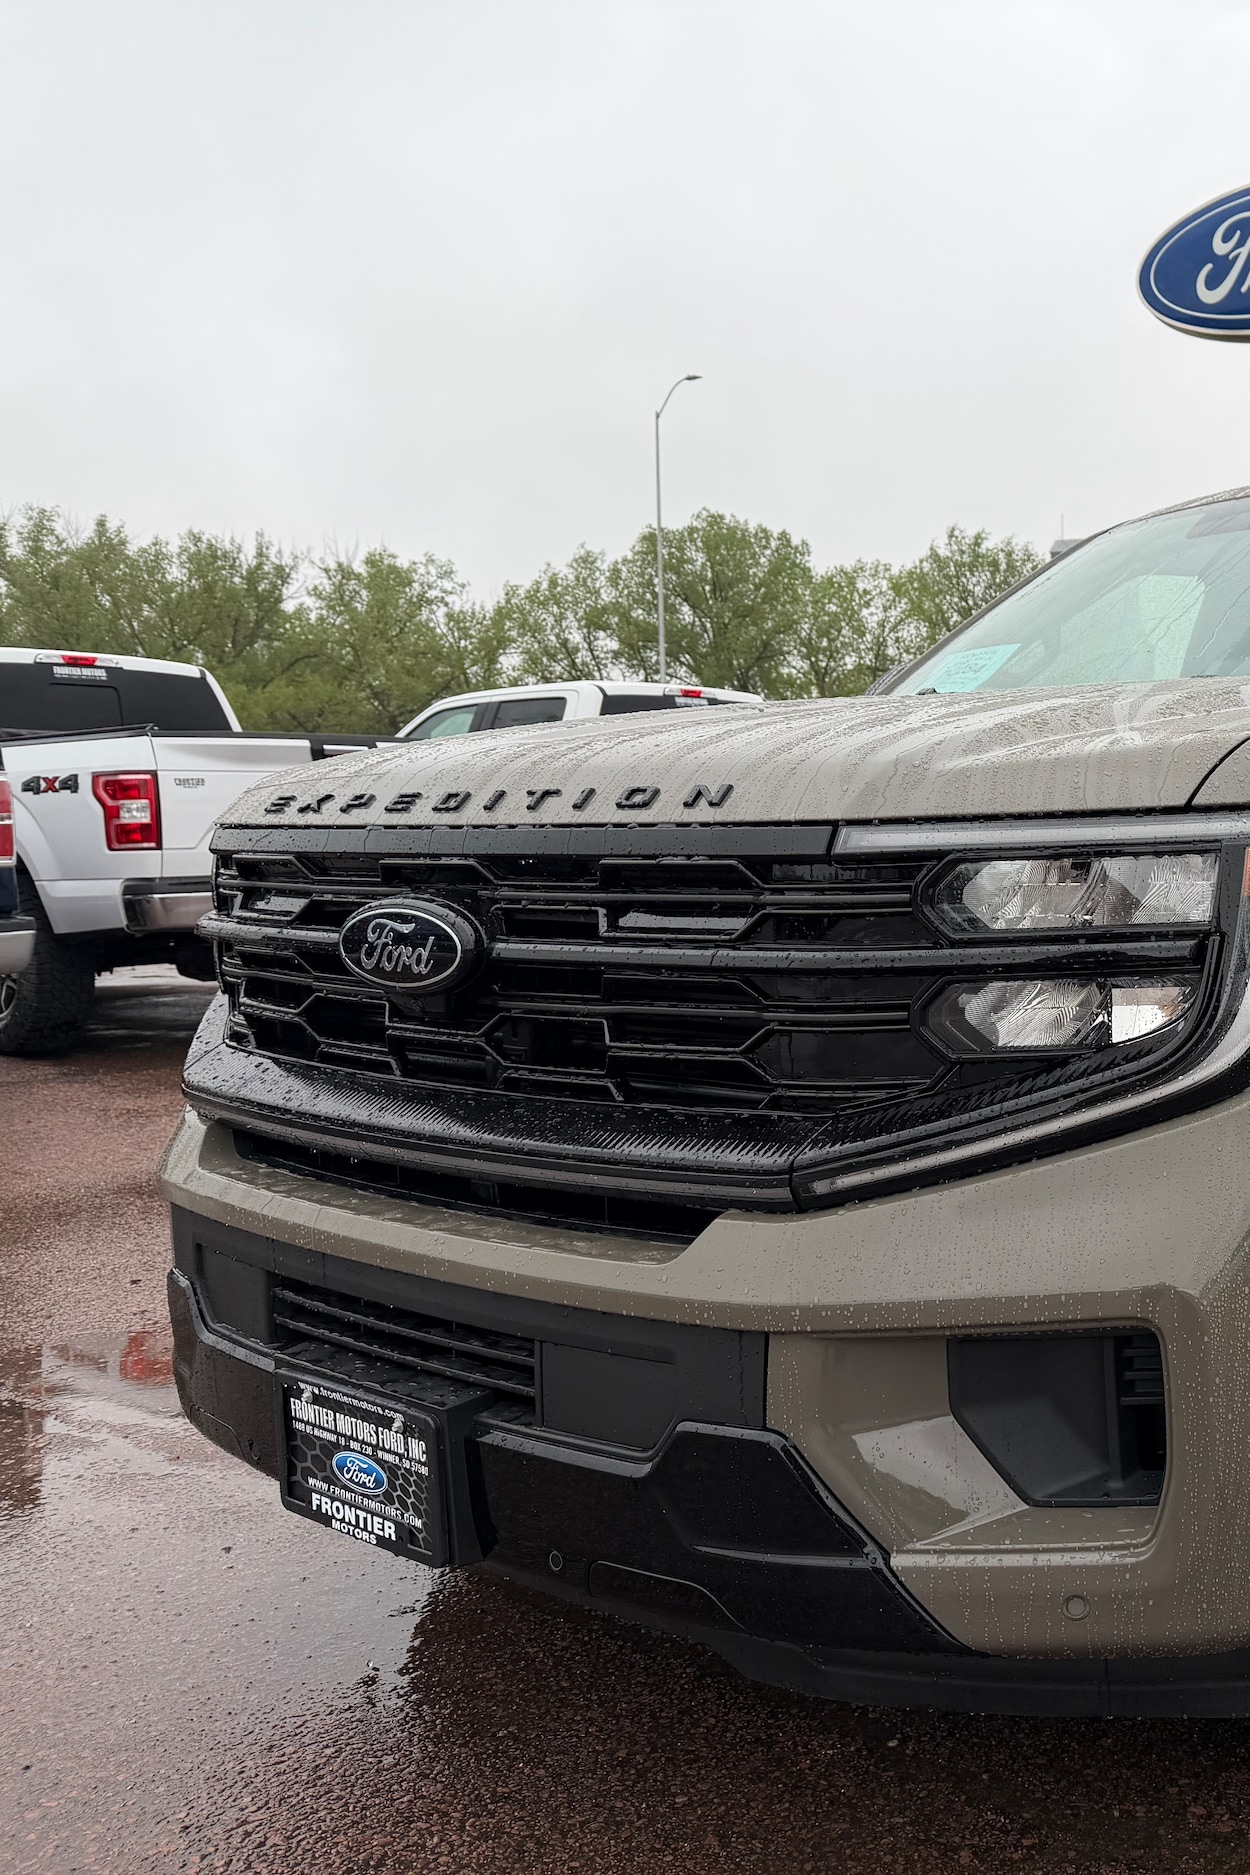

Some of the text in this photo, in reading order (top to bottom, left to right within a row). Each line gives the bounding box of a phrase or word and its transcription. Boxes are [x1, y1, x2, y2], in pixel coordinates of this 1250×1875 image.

[264, 783, 734, 814] EXPEDITION
[360, 918, 435, 975] Ford
[290, 1398, 335, 1431] FRONTIER
[336, 1412, 376, 1445] MOTORS
[306, 1424, 313, 1435] US
[350, 1440, 361, 1452] BOX
[361, 1445, 373, 1456] 230
[411, 1462, 429, 1476] 57580
[343, 1457, 377, 1488] Ford
[312, 1492, 396, 1541] FRONTIER
[331, 1519, 377, 1545] MOTORS
